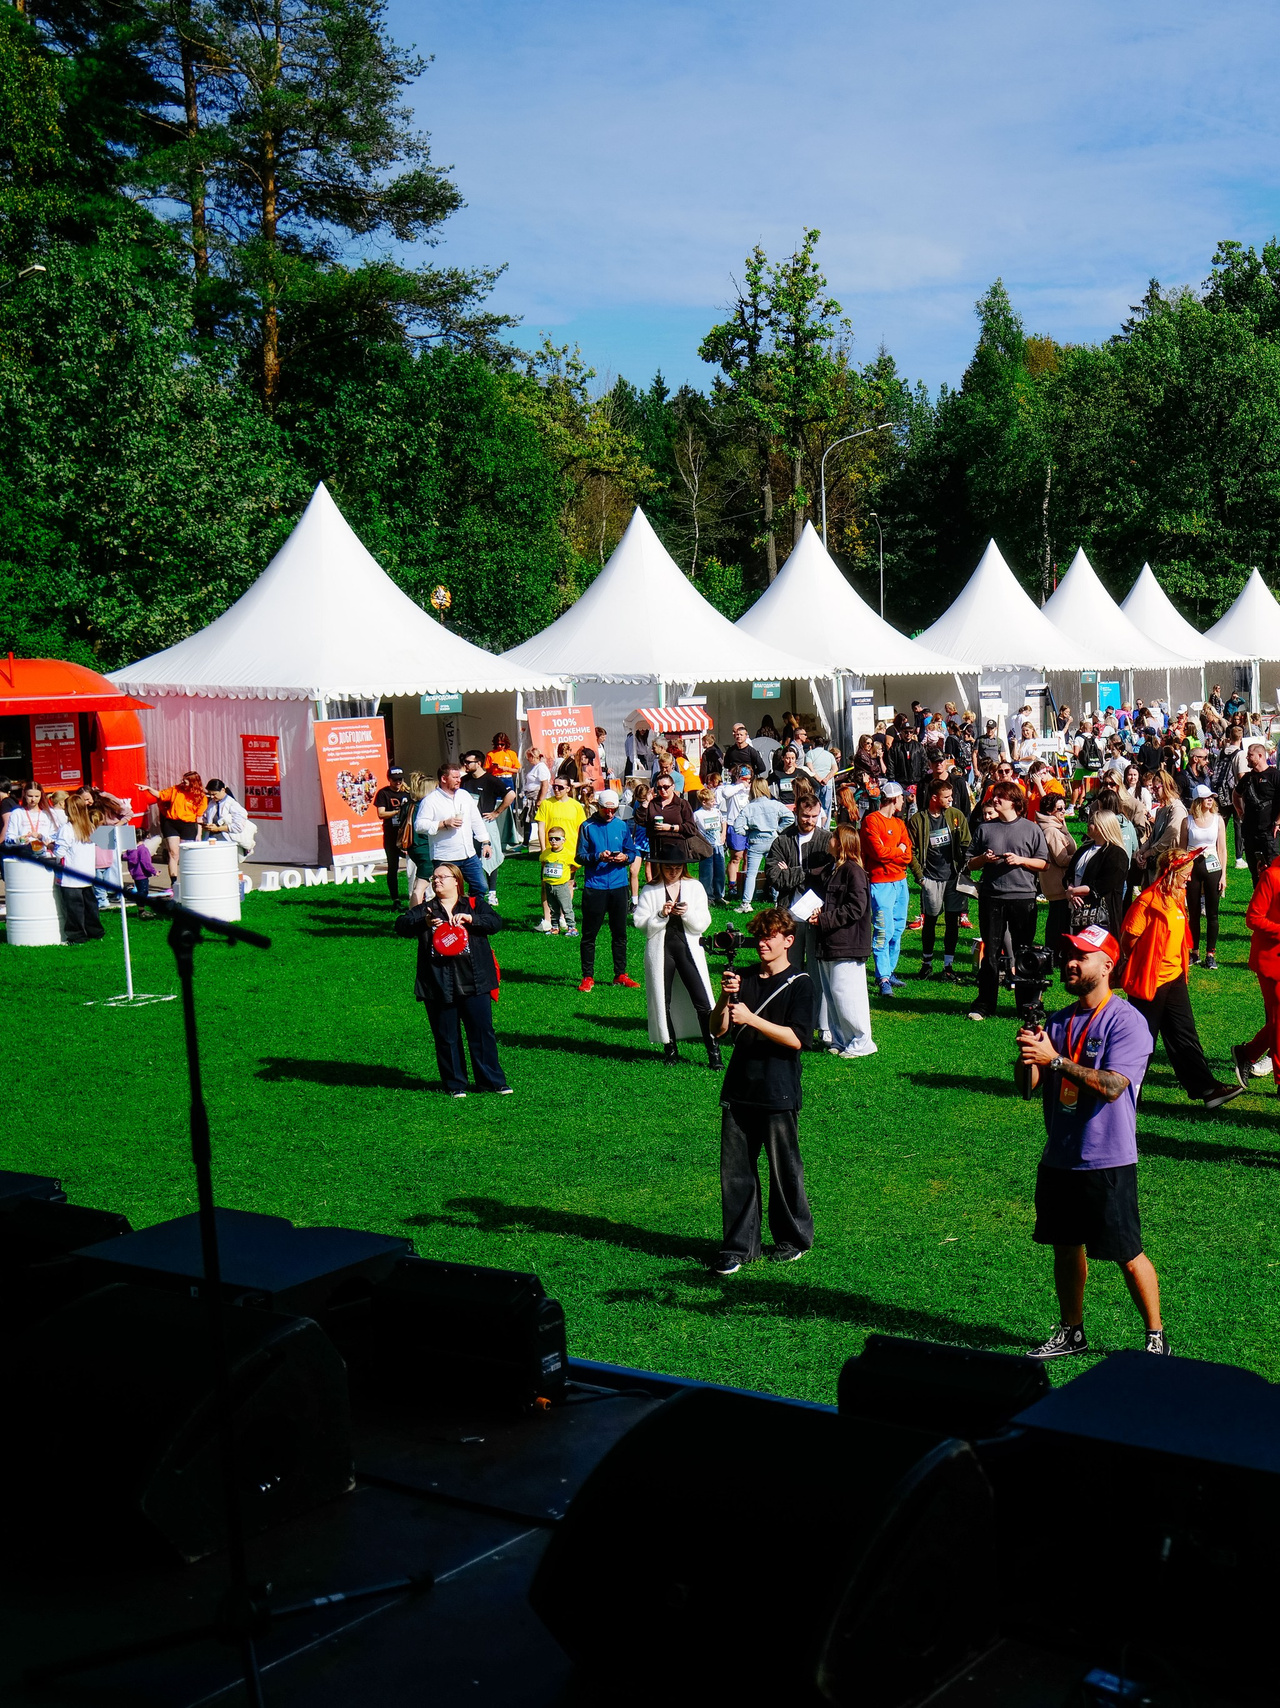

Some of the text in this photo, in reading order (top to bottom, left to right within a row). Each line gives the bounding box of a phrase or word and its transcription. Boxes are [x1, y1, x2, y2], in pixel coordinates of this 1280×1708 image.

[552, 717, 577, 728] 100%
[541, 726, 591, 737] ПОГРУЖЕНИЕ
[558, 735, 585, 744] ДОБРО
[935, 835, 948, 843] 318
